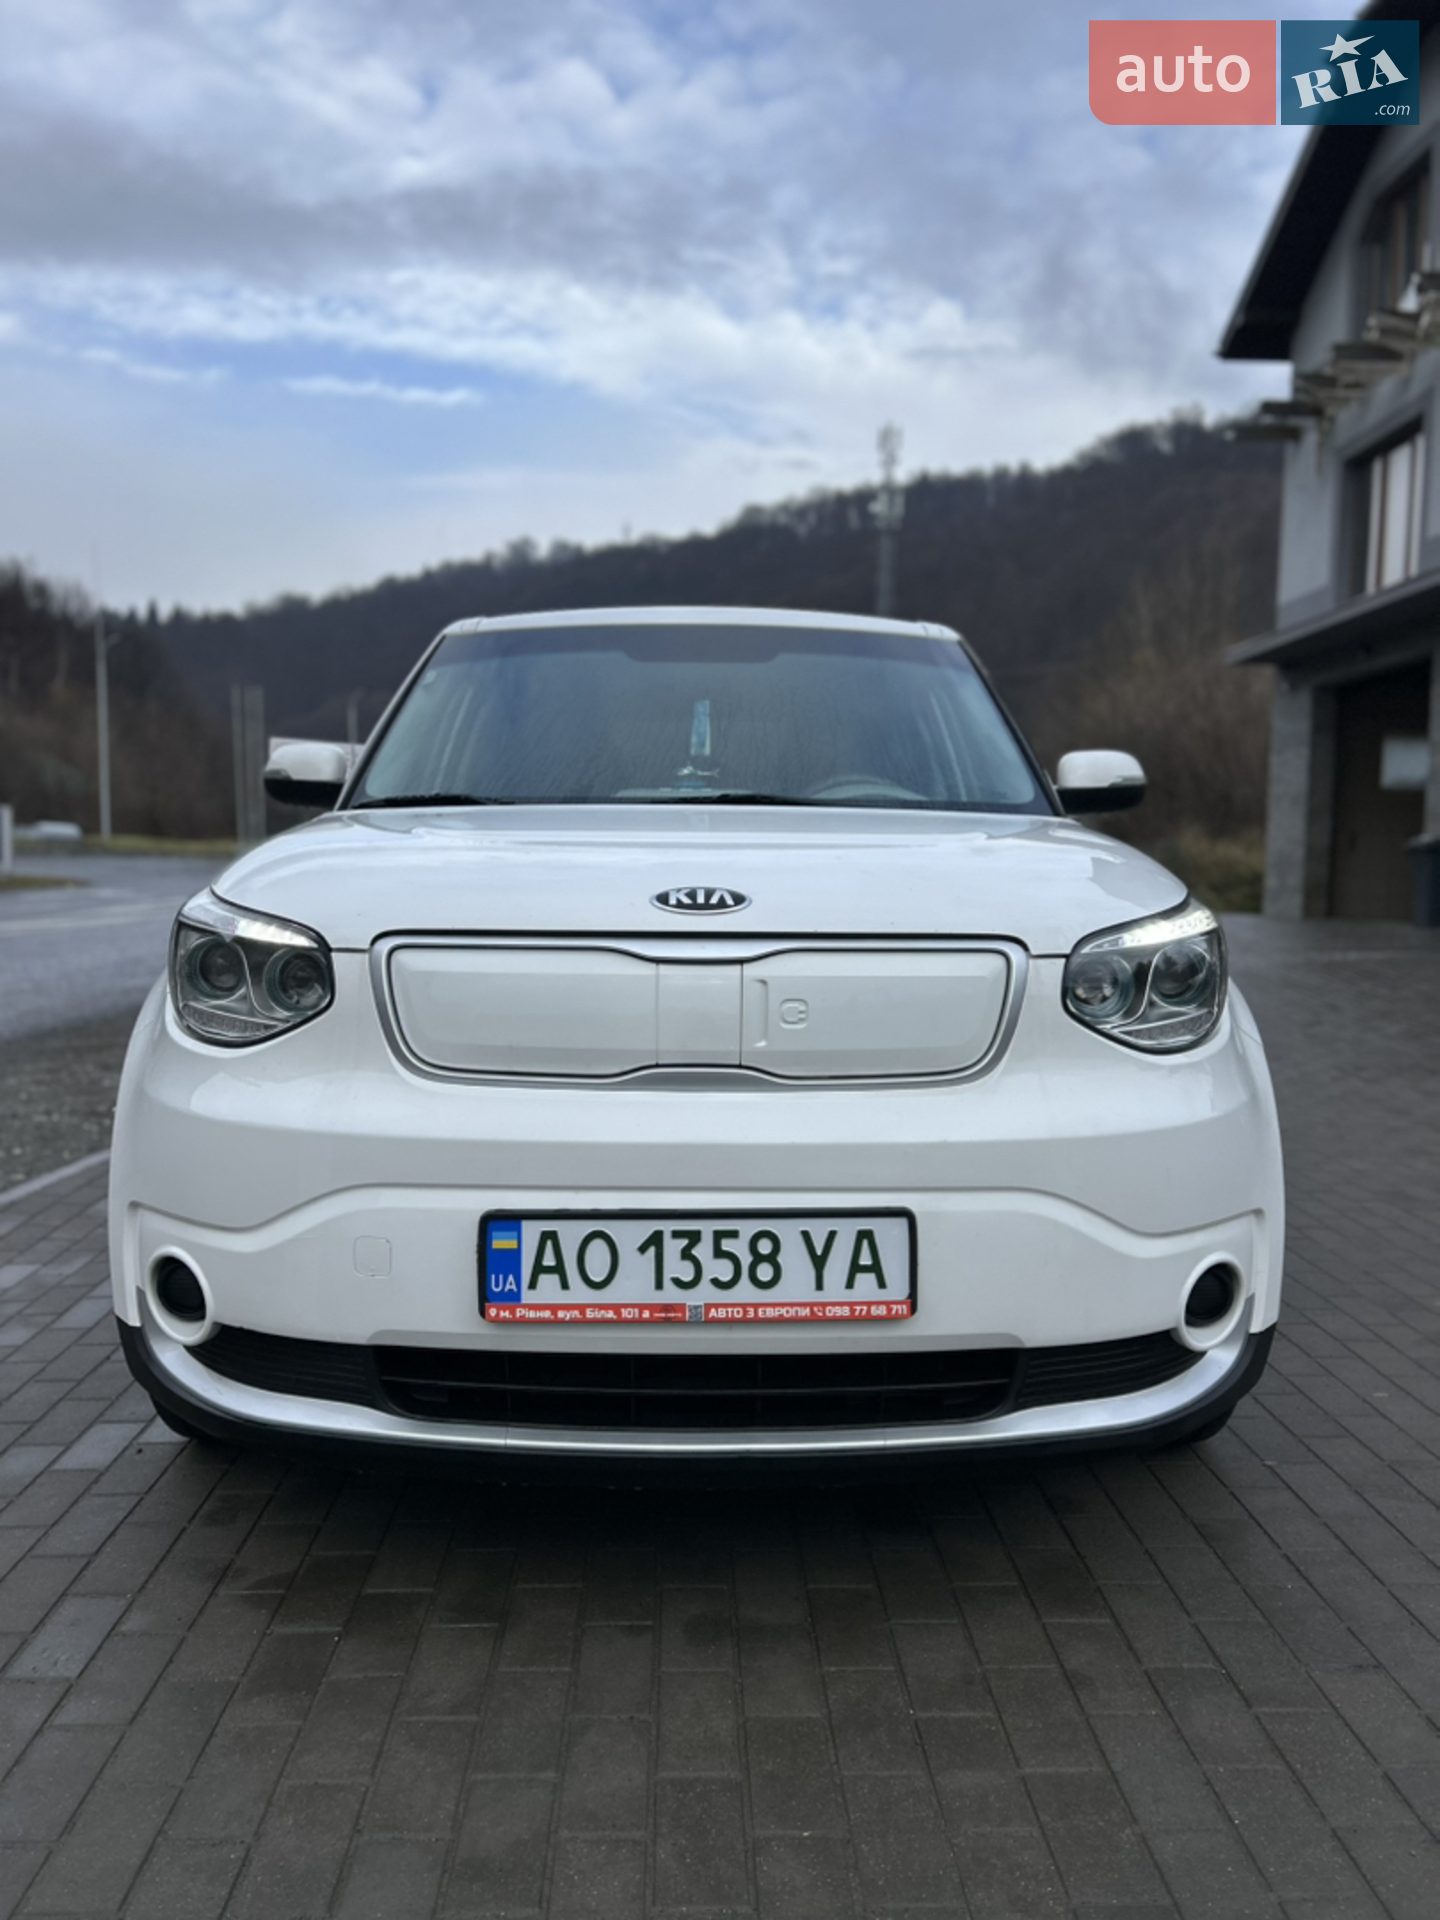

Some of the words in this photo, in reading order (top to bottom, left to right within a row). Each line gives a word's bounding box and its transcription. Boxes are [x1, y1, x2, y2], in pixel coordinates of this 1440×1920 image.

[668, 889, 735, 905] KIA
[528, 1229, 619, 1290] AO
[637, 1229, 782, 1290] 1358
[800, 1229, 887, 1290] YA
[491, 1274, 517, 1292] UA
[516, 1309, 554, 1319] Рівне,
[558, 1311, 583, 1320] вул.
[586, 1309, 617, 1319] Біла,
[621, 1309, 639, 1318] 101
[709, 1308, 743, 1318] АВТО
[758, 1307, 810, 1317] ЄВРОПИ
[825, 1306, 850, 1316] 098
[854, 1306, 867, 1316] 77
[890, 1304, 907, 1314] 711
